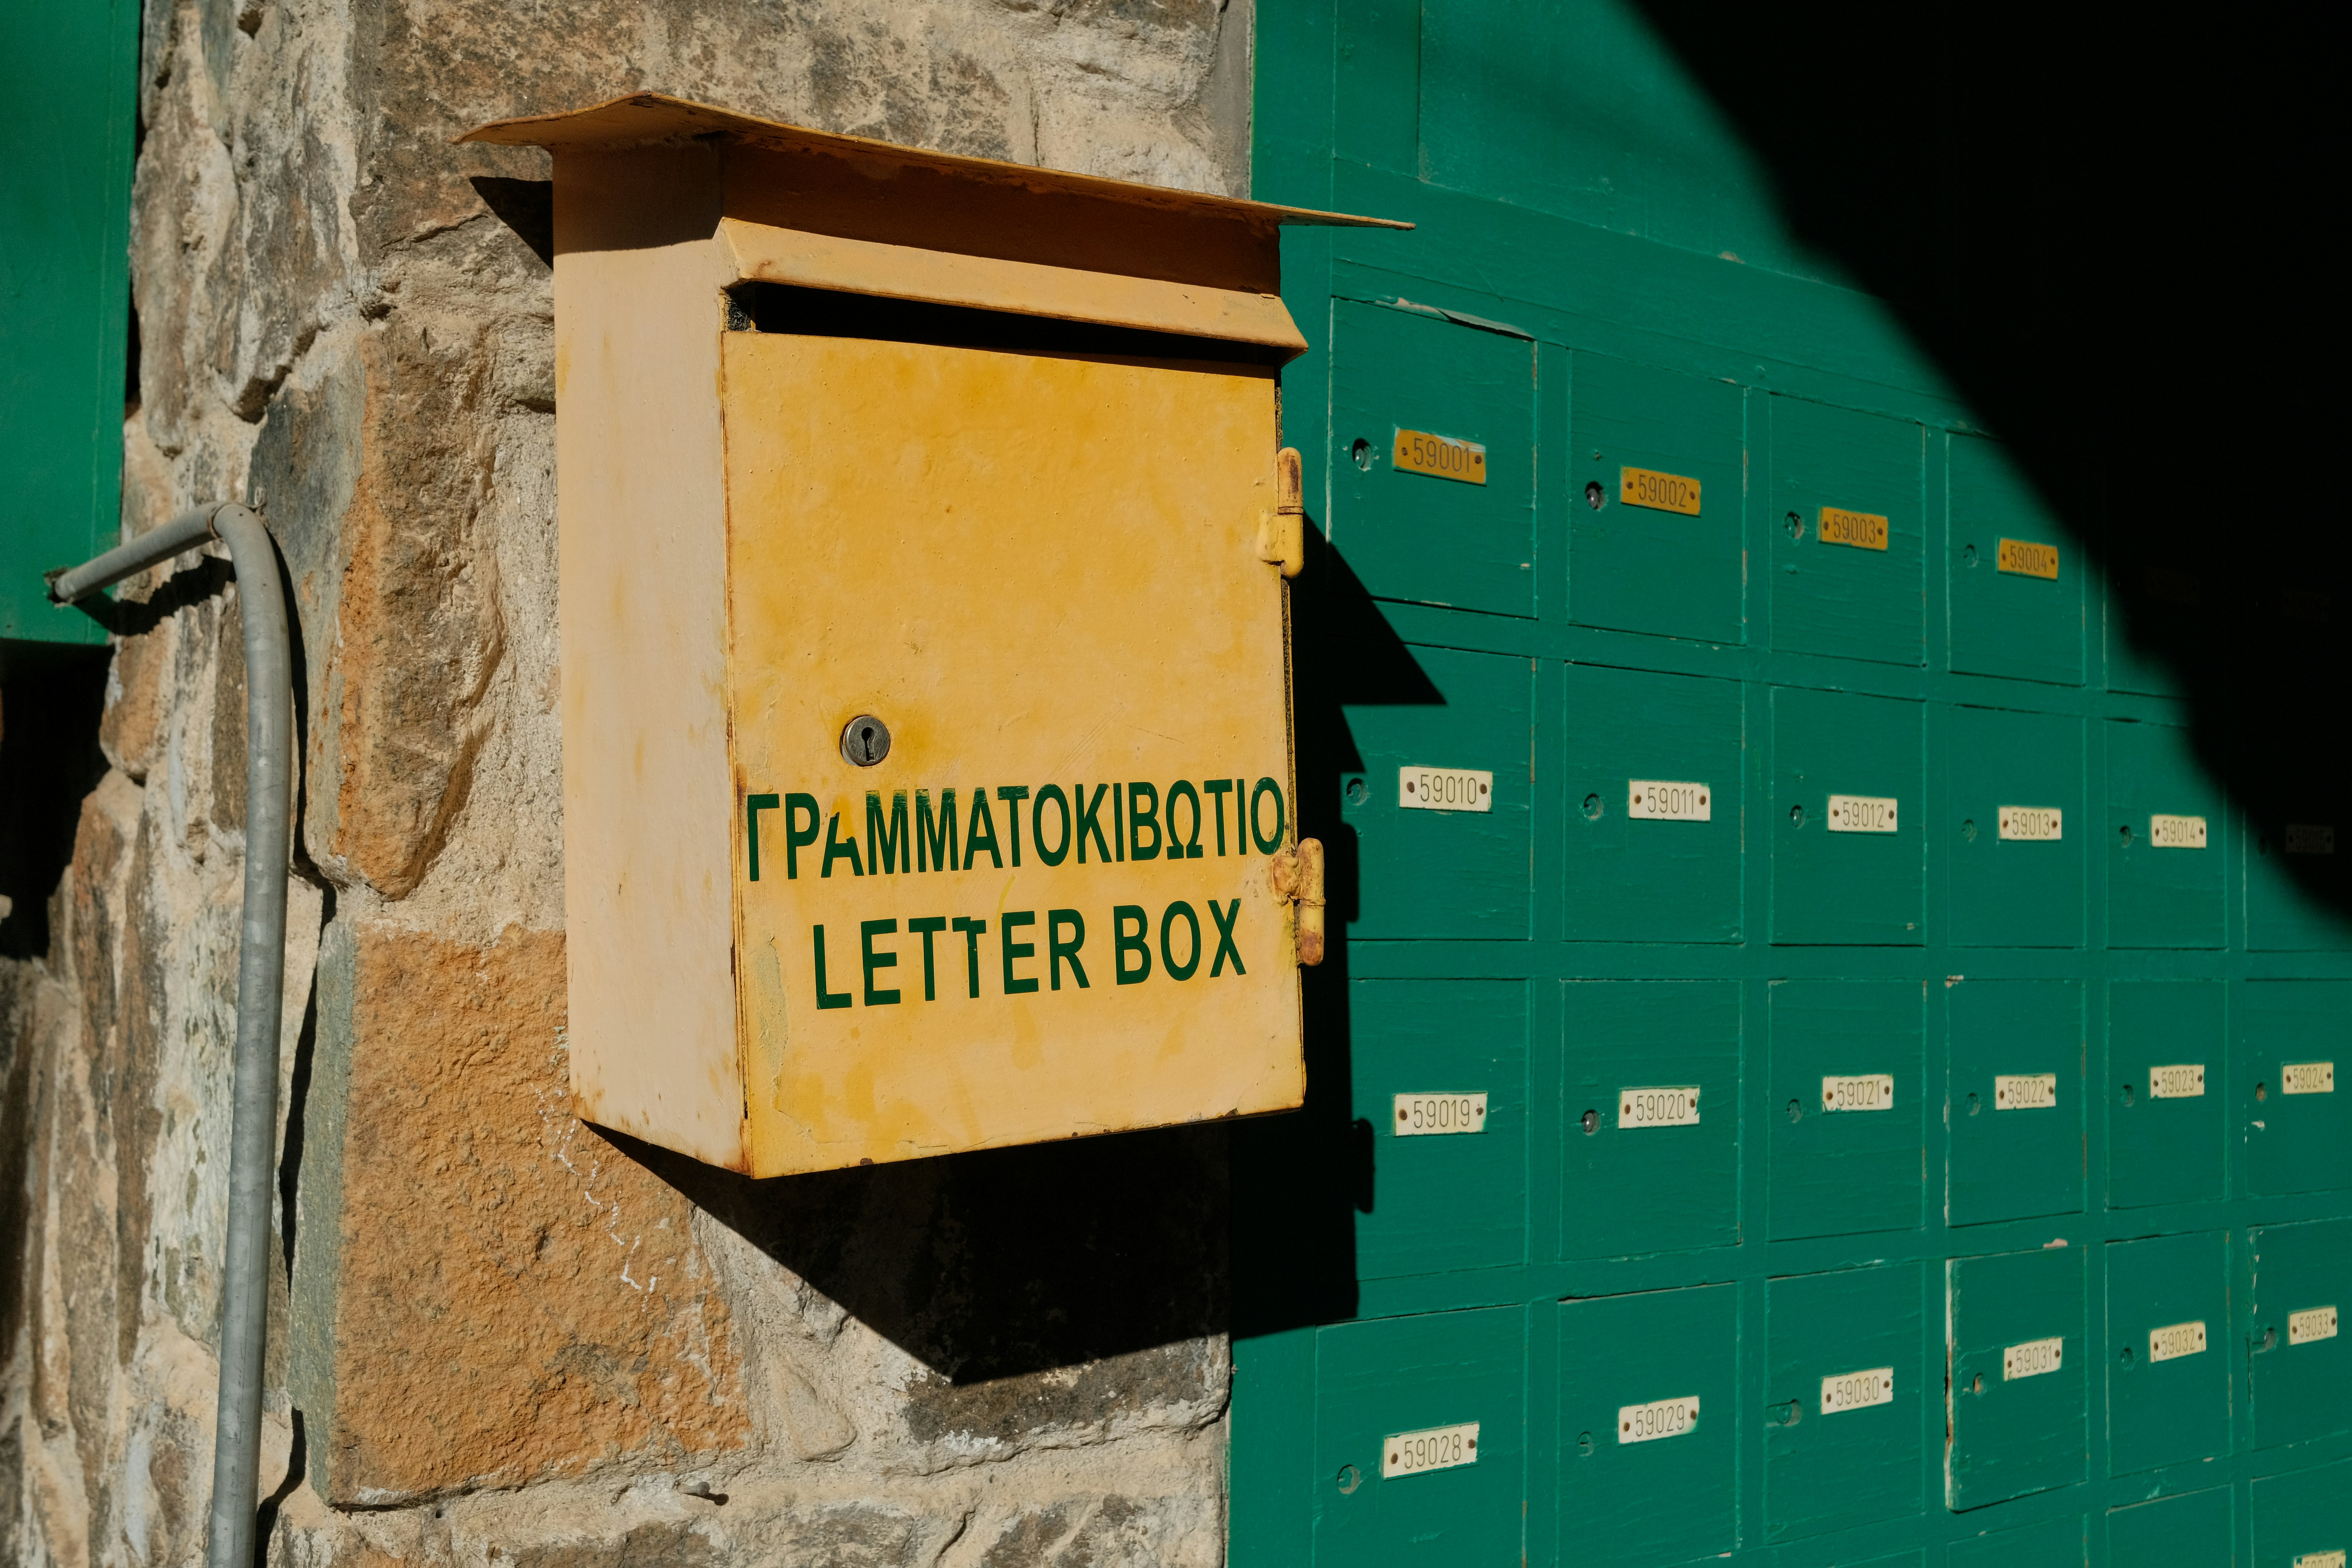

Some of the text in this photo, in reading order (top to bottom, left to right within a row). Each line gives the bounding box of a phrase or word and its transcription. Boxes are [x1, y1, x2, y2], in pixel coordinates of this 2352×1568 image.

[1413, 438, 1470, 473] 59001
[1638, 475, 1687, 507] 59002
[1833, 514, 1876, 544] 59003
[2010, 545, 2047, 571] 59004
[1420, 774, 1477, 804] 59010
[1648, 787, 1694, 814] 59011
[1843, 802, 1884, 828] 59012
[2012, 812, 2049, 836] 59013
[747, 776, 1285, 882] ΓΡΑΜΜΑΤΟΚΙΒΩΤΙΟ
[2162, 820, 2195, 842] 59014
[813, 898, 1246, 1010] LETTER BOX
[2008, 1080, 2045, 1104] 59022
[2162, 1069, 2194, 1093] 59023
[2294, 1068, 2323, 1089] 59024
[1637, 1094, 1685, 1121] 59020
[1838, 1081, 1880, 1107] 59021
[1414, 1099, 1470, 1128] 59019
[2300, 1313, 2328, 1338] 59033
[2161, 1329, 2194, 1356] 59032
[2016, 1345, 2052, 1374] 59031
[1836, 1376, 1879, 1406] 59030
[1635, 1404, 1685, 1436] 59029
[1404, 1433, 1461, 1469] 59028
